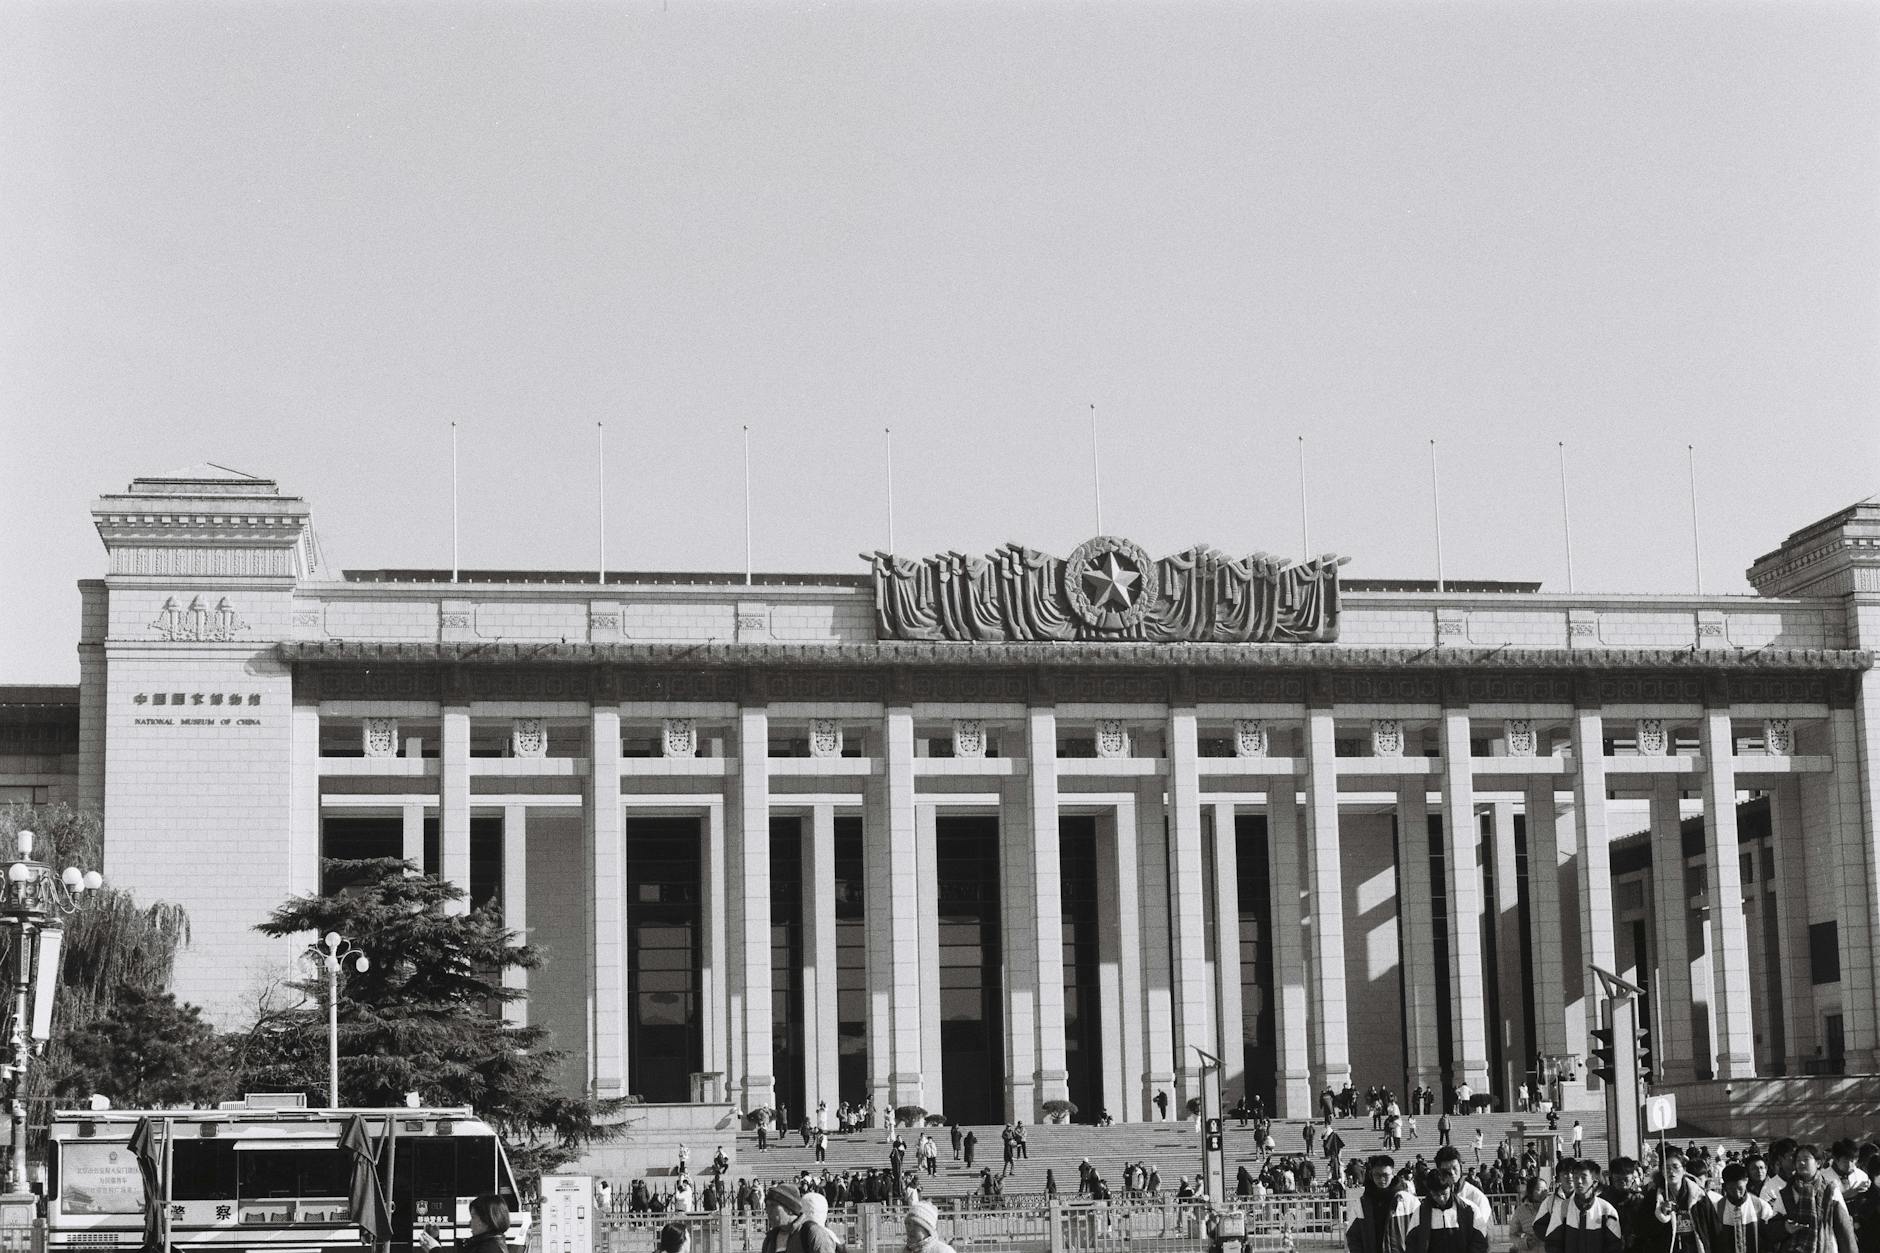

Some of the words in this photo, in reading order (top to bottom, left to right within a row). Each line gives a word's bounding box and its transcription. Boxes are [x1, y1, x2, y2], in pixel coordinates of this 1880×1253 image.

[135, 718, 174, 726] NATIONAL
[181, 718, 214, 726] MUSEUM
[220, 718, 231, 726] OF
[236, 718, 261, 726] CHINA
